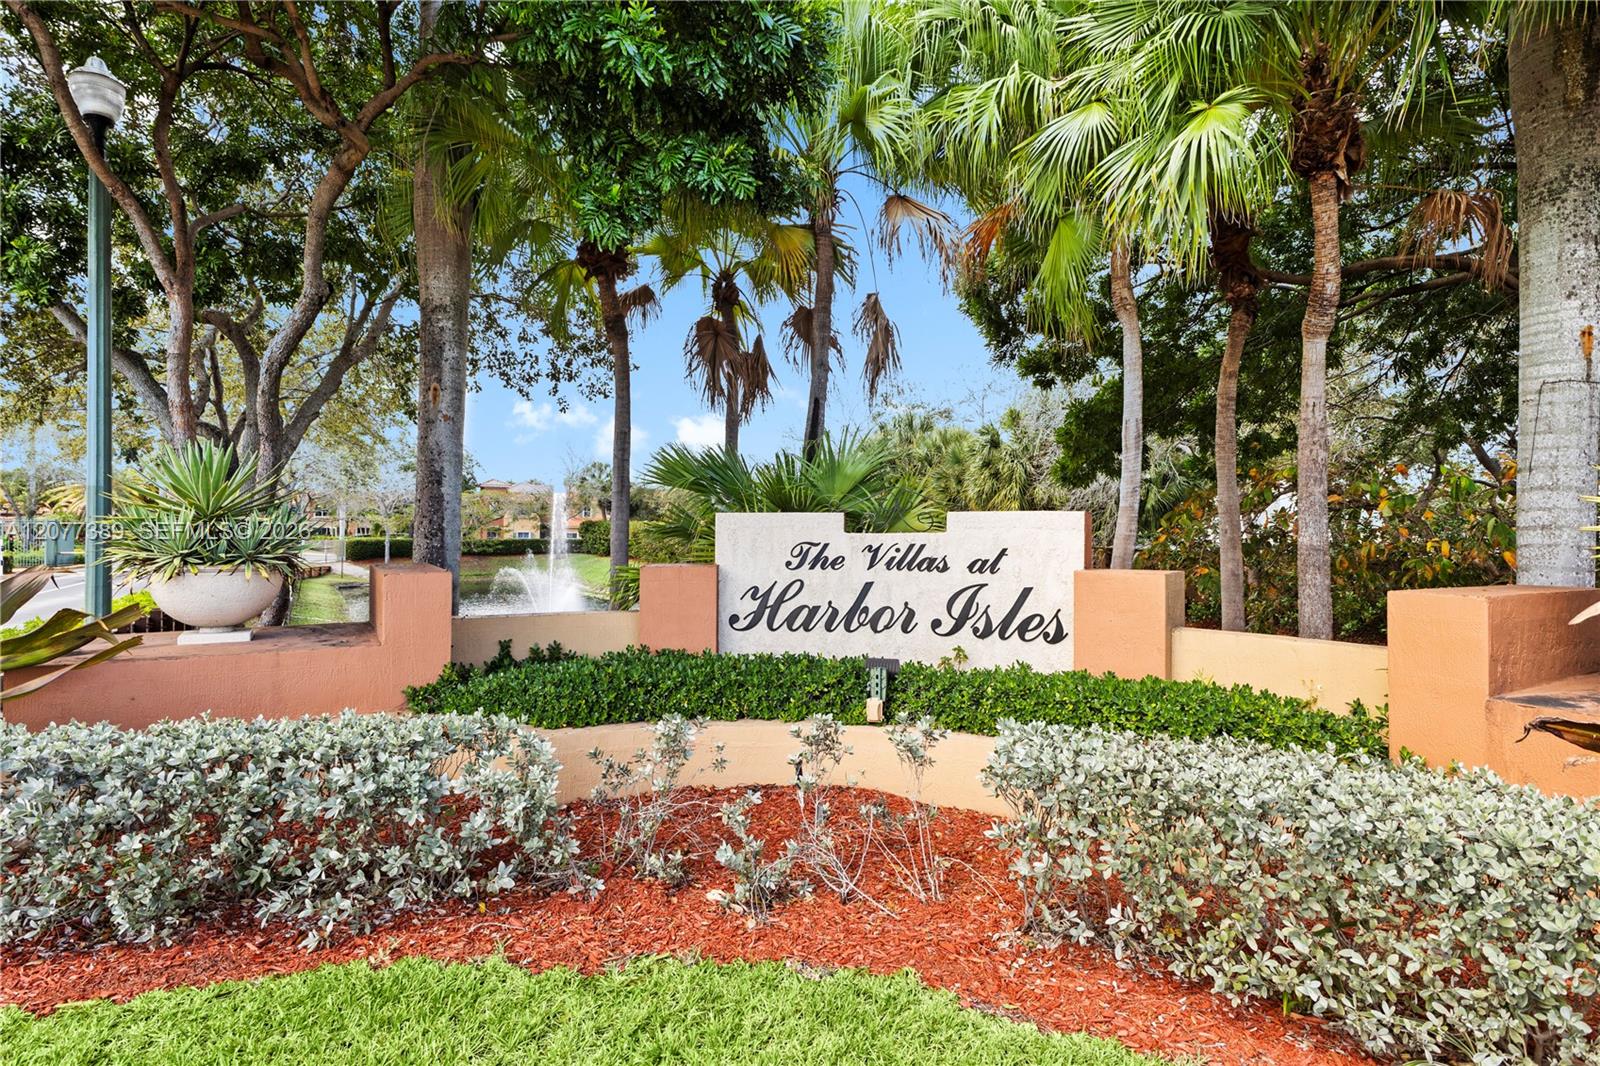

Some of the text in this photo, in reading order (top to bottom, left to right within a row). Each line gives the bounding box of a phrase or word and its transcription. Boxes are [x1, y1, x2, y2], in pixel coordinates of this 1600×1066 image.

[785, 541, 1008, 574] The Villas at
[728, 579, 1070, 645] Harbor Isles
